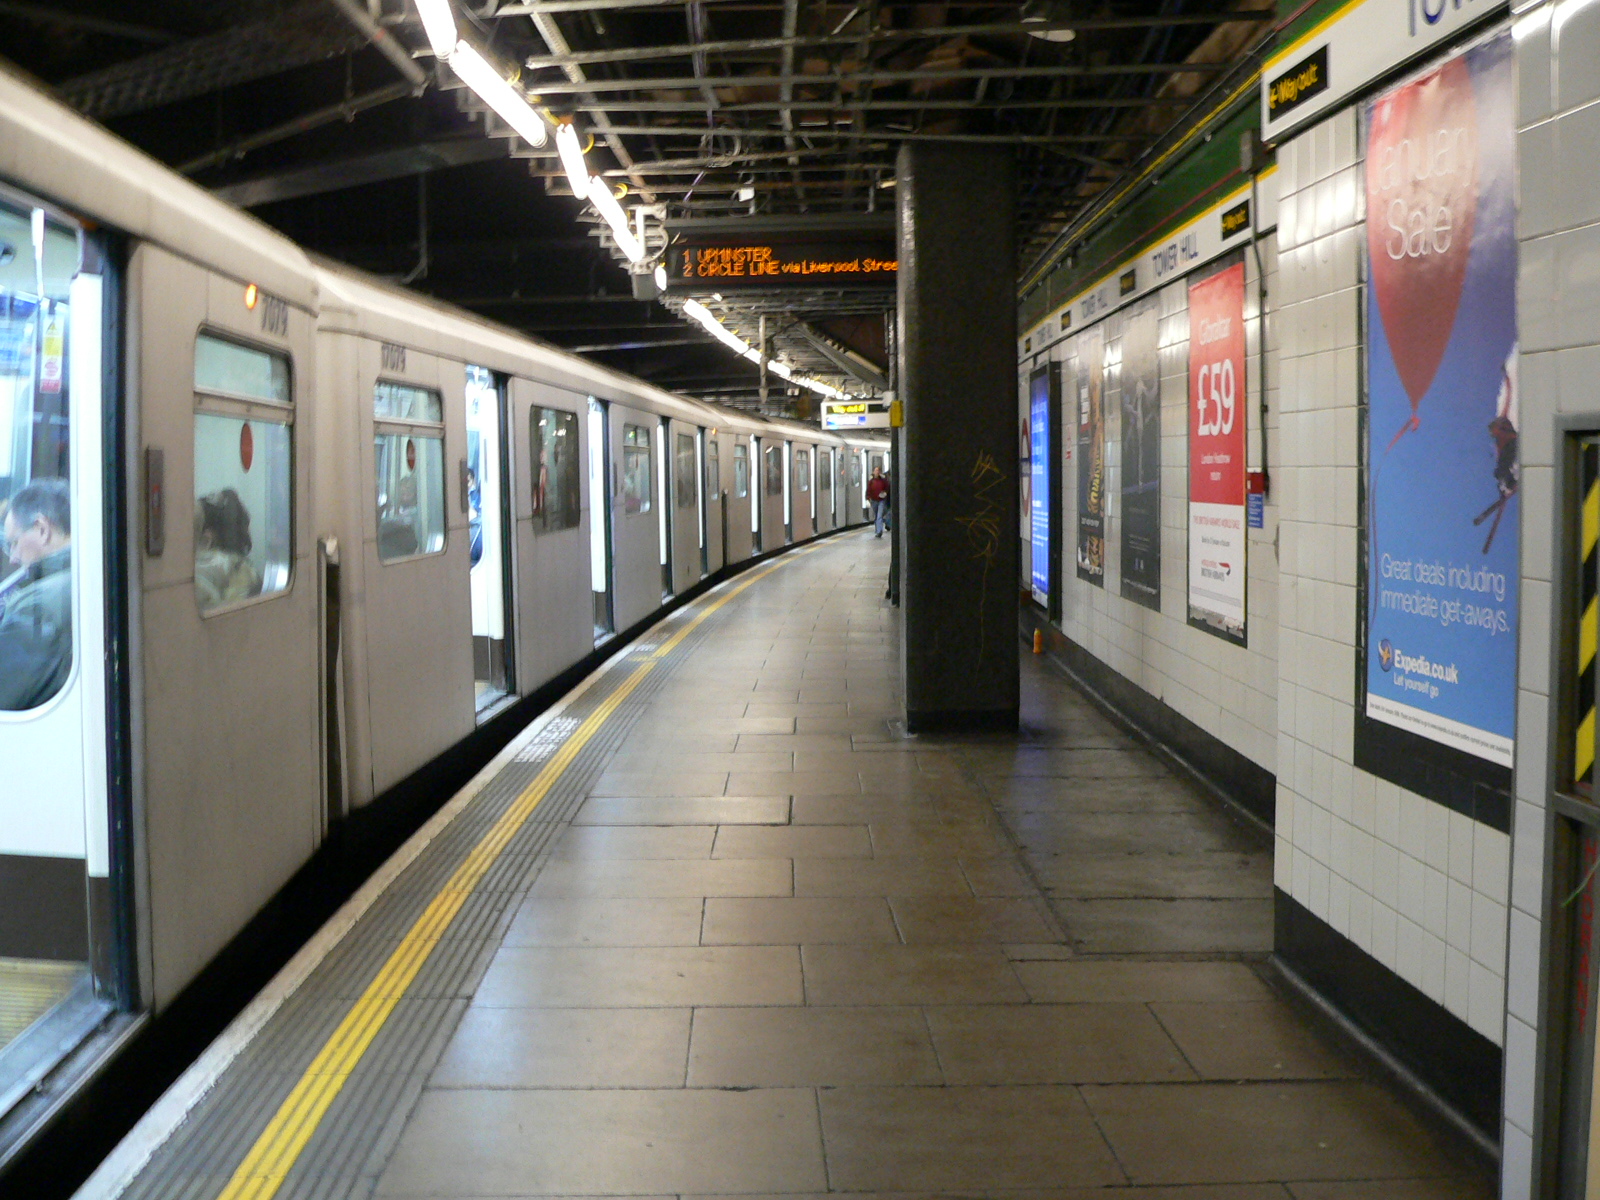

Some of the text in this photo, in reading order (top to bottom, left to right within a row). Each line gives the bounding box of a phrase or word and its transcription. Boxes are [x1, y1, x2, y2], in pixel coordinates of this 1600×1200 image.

[1386, 197, 1453, 260] Sale
[682, 246, 773, 263] 1 UPMINSTER
[682, 262, 694, 277] 2
[697, 261, 745, 277] CIRCLE
[749, 260, 780, 276] LINE
[781, 261, 800, 274] via
[801, 258, 860, 275] Liverpool
[1152, 231, 1198, 277] TOWER HILL
[1197, 358, 1236, 437] £59
[1381, 553, 1506, 602] Great deals including
[1381, 584, 1510, 636] immediate get-aways.
[1393, 672, 1405, 687] Let
[1429, 685, 1440, 699] go
[1394, 649, 1459, 685] Expedia.co.uk
